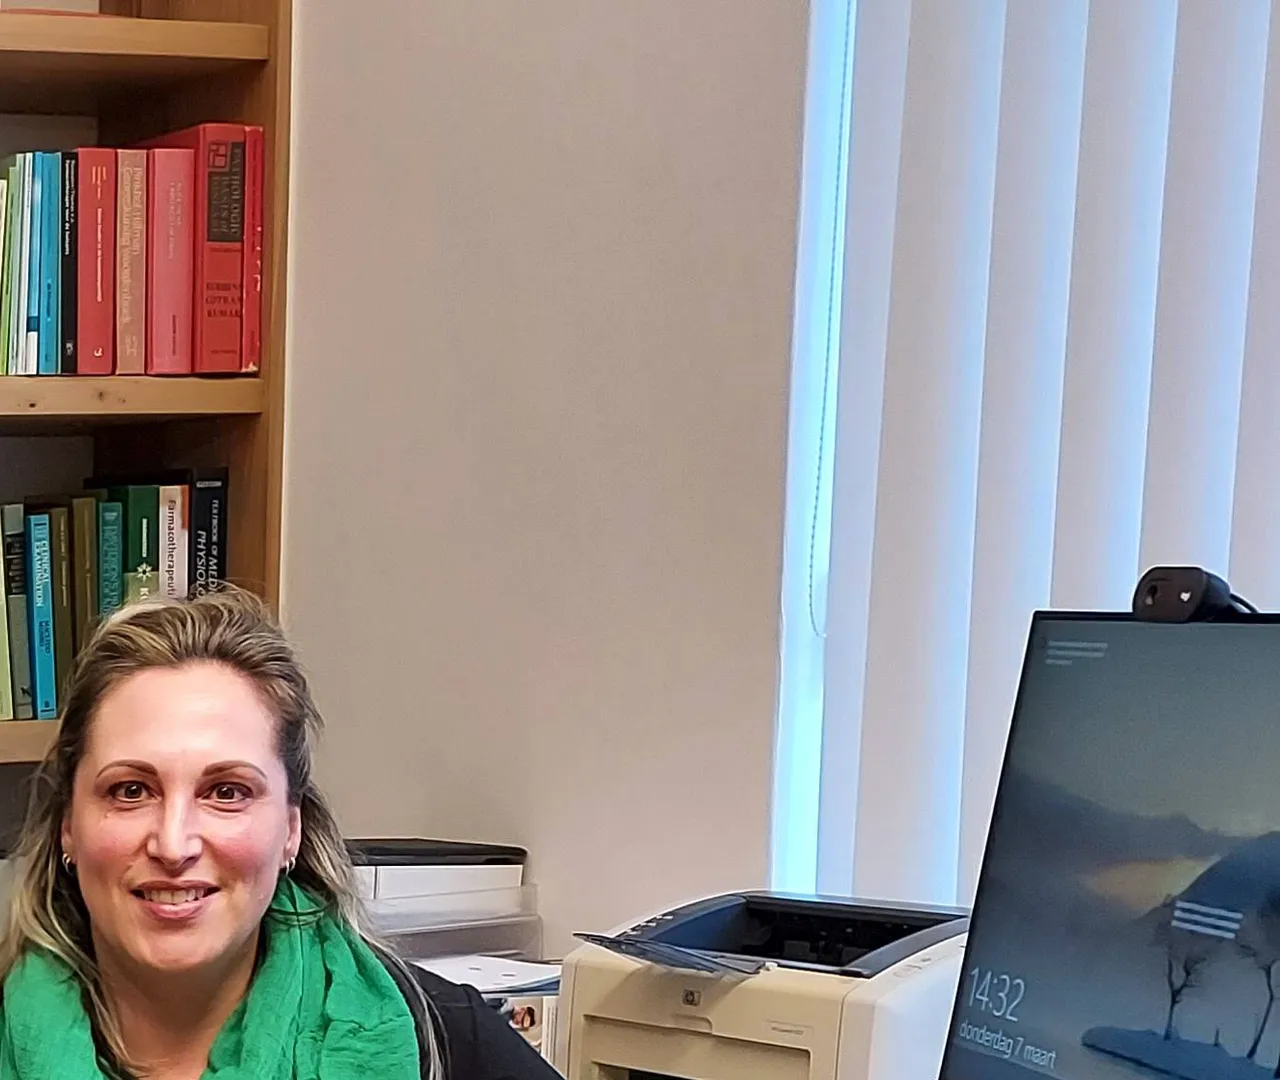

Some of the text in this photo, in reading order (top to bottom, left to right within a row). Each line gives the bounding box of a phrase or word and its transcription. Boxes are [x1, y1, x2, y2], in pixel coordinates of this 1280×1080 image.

[35, 541, 44, 607] EXAMINATION
[41, 540, 50, 583] CLINICAL
[166, 500, 176, 596] Farmacotherapeuti
[196, 530, 207, 598] PHYSIOLO
[208, 557, 218, 596] MEDI
[970, 967, 1025, 1022] 14:32
[960, 1020, 1056, 1068] donderdag 7 maart
